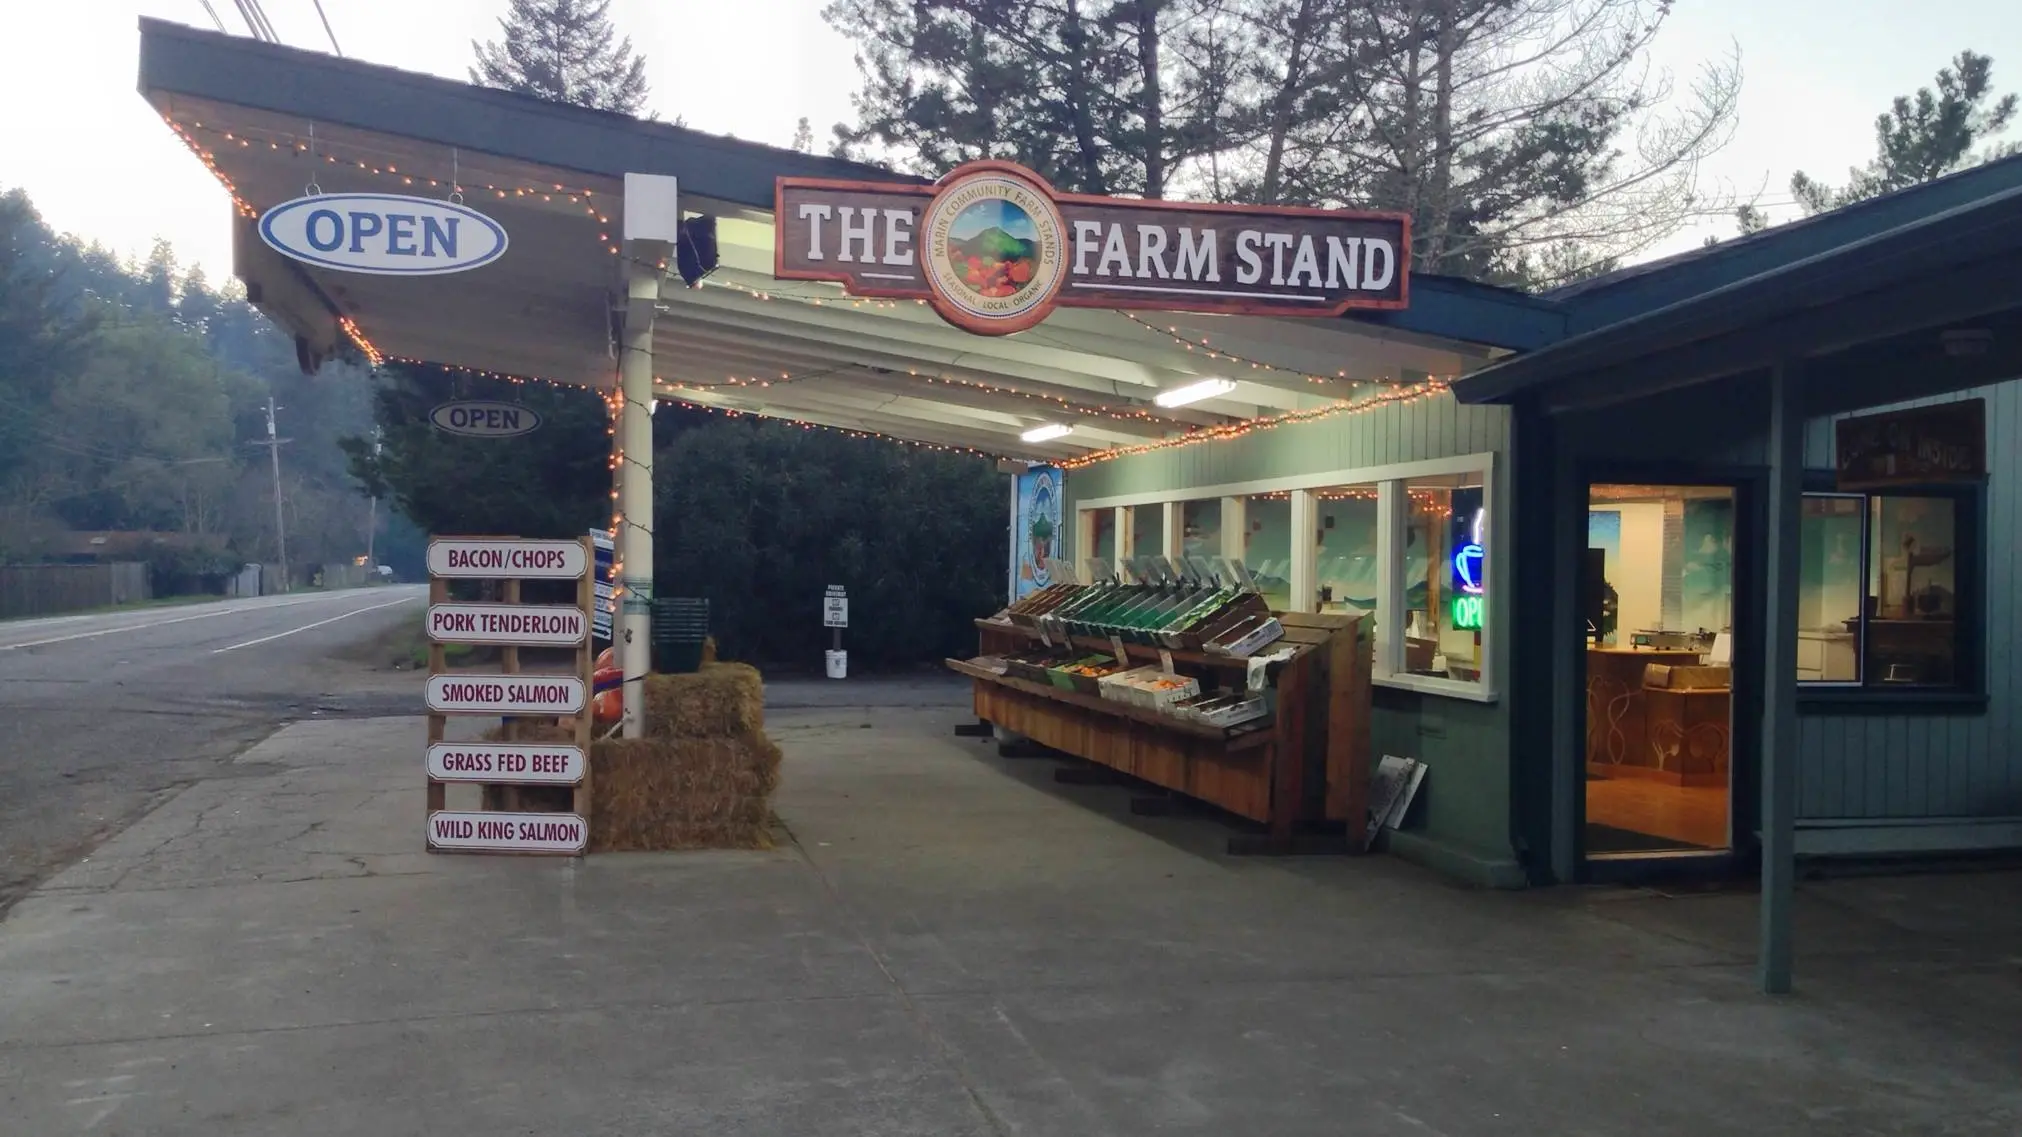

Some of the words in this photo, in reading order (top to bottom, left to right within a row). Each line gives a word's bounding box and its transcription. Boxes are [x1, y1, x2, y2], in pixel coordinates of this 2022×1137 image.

[305, 209, 460, 258] OPEN
[935, 218, 949, 257] MARIN
[946, 184, 1012, 216] COMMUNITY
[1014, 192, 1042, 217] FARM
[1039, 220, 1056, 265] STANDS
[799, 204, 914, 265] THE
[1072, 220, 1220, 282] FARM
[1236, 229, 1394, 290] STAND
[982, 300, 1010, 310] LOCAL
[449, 409, 520, 430] OPEN
[448, 549, 565, 569] BACON/CHOPS
[433, 613, 475, 631] PORK
[480, 614, 579, 634] TENDERLOIN
[442, 684, 503, 702] SMOKED
[507, 684, 569, 704] SALMON
[443, 753, 492, 771] GRASS
[497, 754, 526, 772] FED
[531, 755, 569, 773] BEEF
[435, 820, 473, 838] WILD
[478, 821, 514, 840] KING
[519, 822, 579, 842] SALMON
